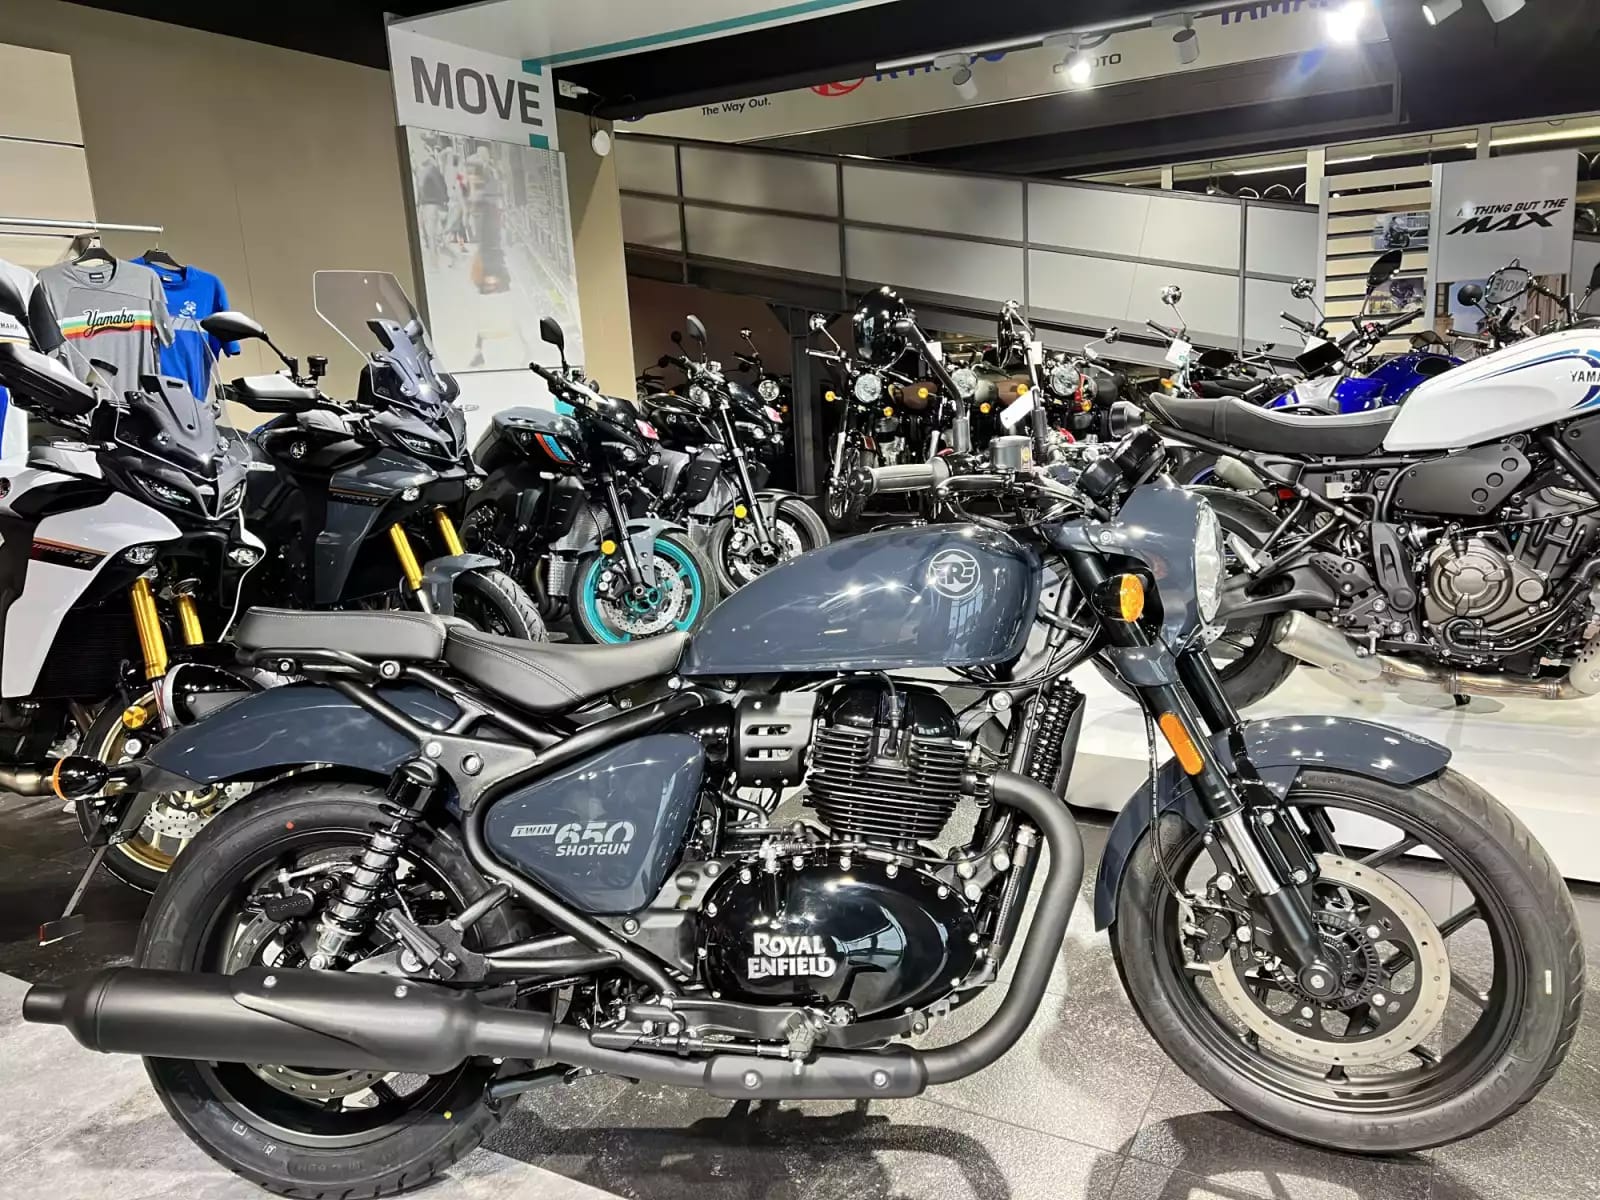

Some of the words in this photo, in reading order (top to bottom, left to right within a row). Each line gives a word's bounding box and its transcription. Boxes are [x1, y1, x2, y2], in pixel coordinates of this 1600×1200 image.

[411, 56, 543, 127] MOVE
[701, 107, 719, 115] The
[722, 102, 745, 114] Way
[748, 97, 772, 108] Out.
[1457, 203, 1513, 217] THING
[1513, 200, 1541, 212] BUT
[1543, 198, 1569, 209] THE
[1446, 209, 1562, 236] MAX
[83, 309, 136, 338] Yamaha
[515, 825, 554, 836] TWIN
[555, 821, 636, 844] 650
[555, 843, 631, 857] SHOTGUN
[753, 932, 826, 958] ROYAL
[748, 956, 837, 980] ENFIELD
